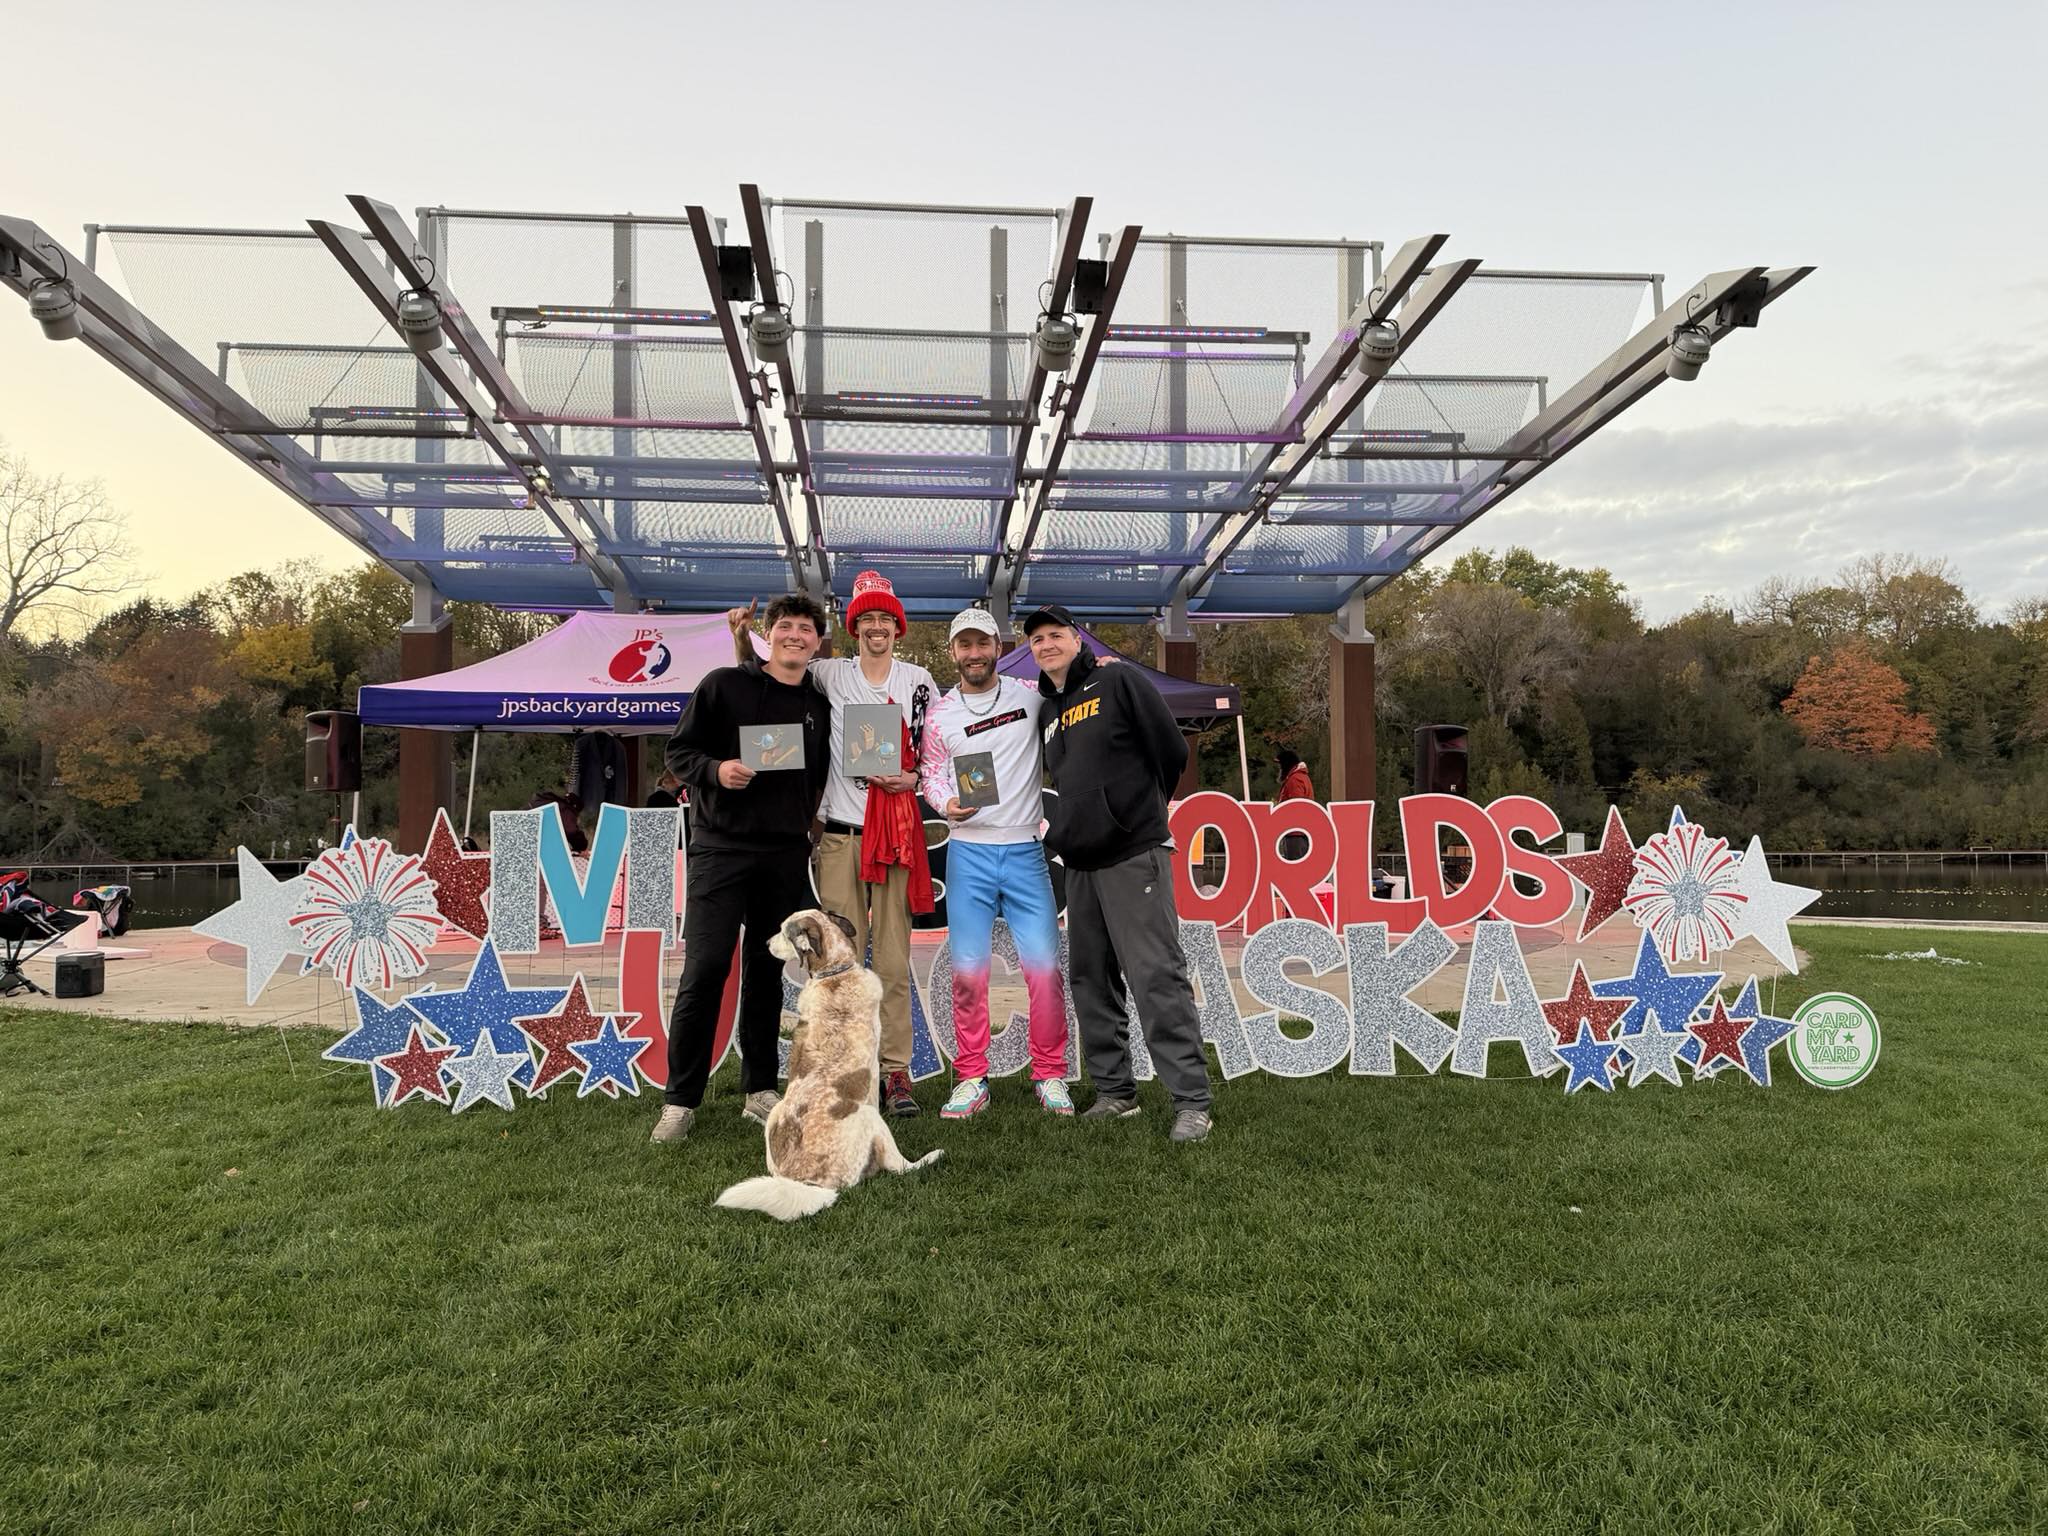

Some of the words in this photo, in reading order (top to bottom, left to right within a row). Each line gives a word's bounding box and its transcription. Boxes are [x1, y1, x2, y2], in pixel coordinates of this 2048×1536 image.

[630, 628, 664, 642] JP's
[1061, 696, 1101, 731] STATE
[1167, 791, 1576, 938] ORLDS
[1806, 1012, 1862, 1029] CARD
[1806, 1029, 1840, 1046] MY
[1807, 1046, 1861, 1063] YARD
